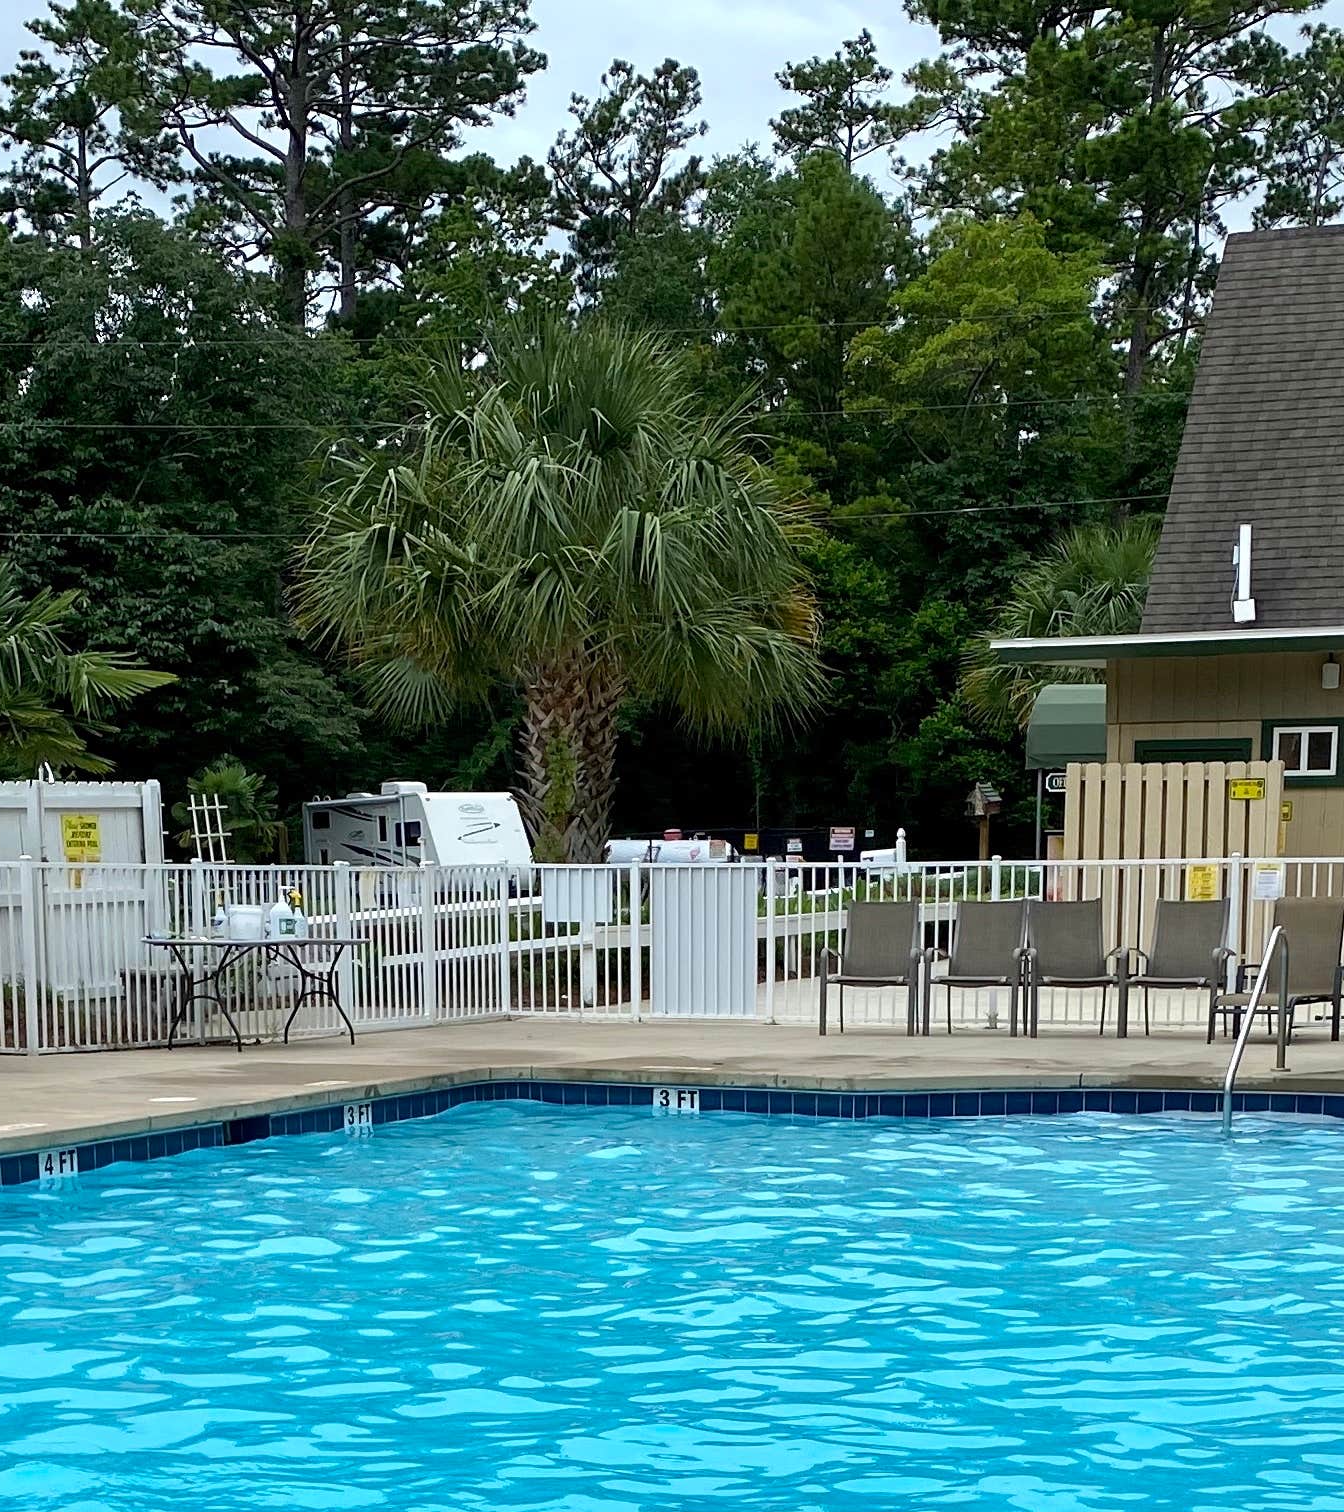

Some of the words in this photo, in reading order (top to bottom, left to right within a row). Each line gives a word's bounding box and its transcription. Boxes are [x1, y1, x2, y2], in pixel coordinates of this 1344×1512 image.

[659, 1089, 670, 1107] 3
[677, 1090, 698, 1109] FT
[347, 1106, 355, 1126] 3
[358, 1103, 371, 1125] FT
[44, 1153, 54, 1175] 4
[59, 1149, 76, 1174] FT
